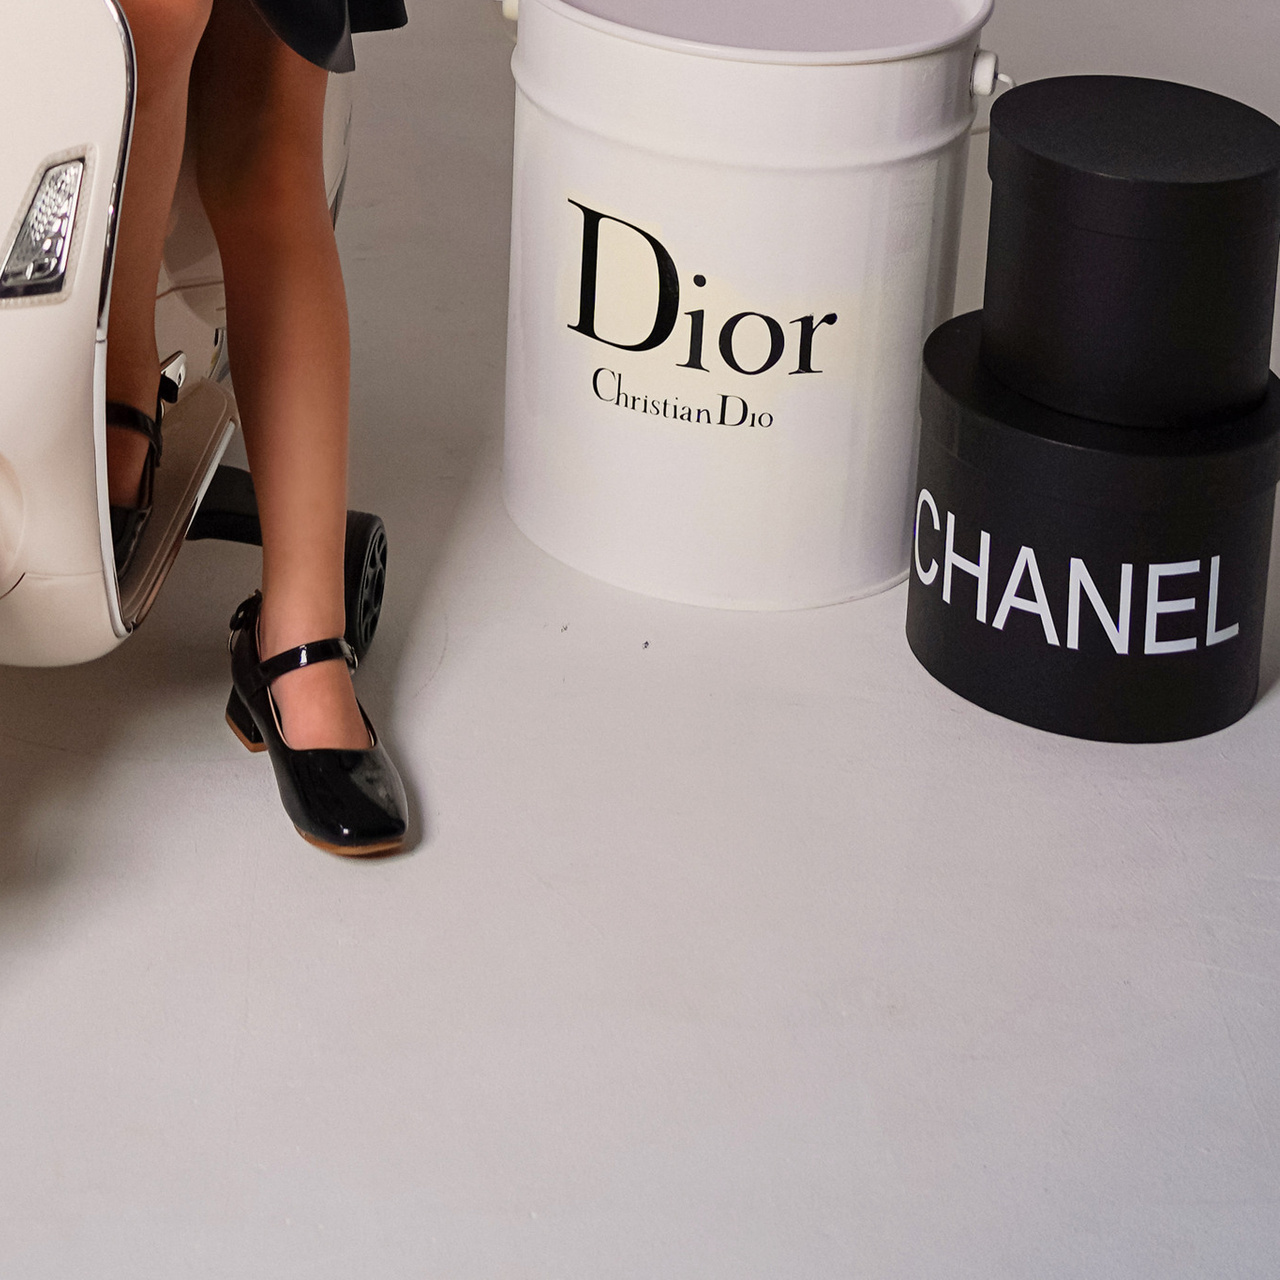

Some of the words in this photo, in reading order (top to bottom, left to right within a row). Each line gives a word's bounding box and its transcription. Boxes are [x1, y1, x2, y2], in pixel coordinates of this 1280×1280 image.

[567, 197, 838, 376] Dior
[592, 367, 712, 425] Christian
[914, 488, 1240, 656] CHANEL
